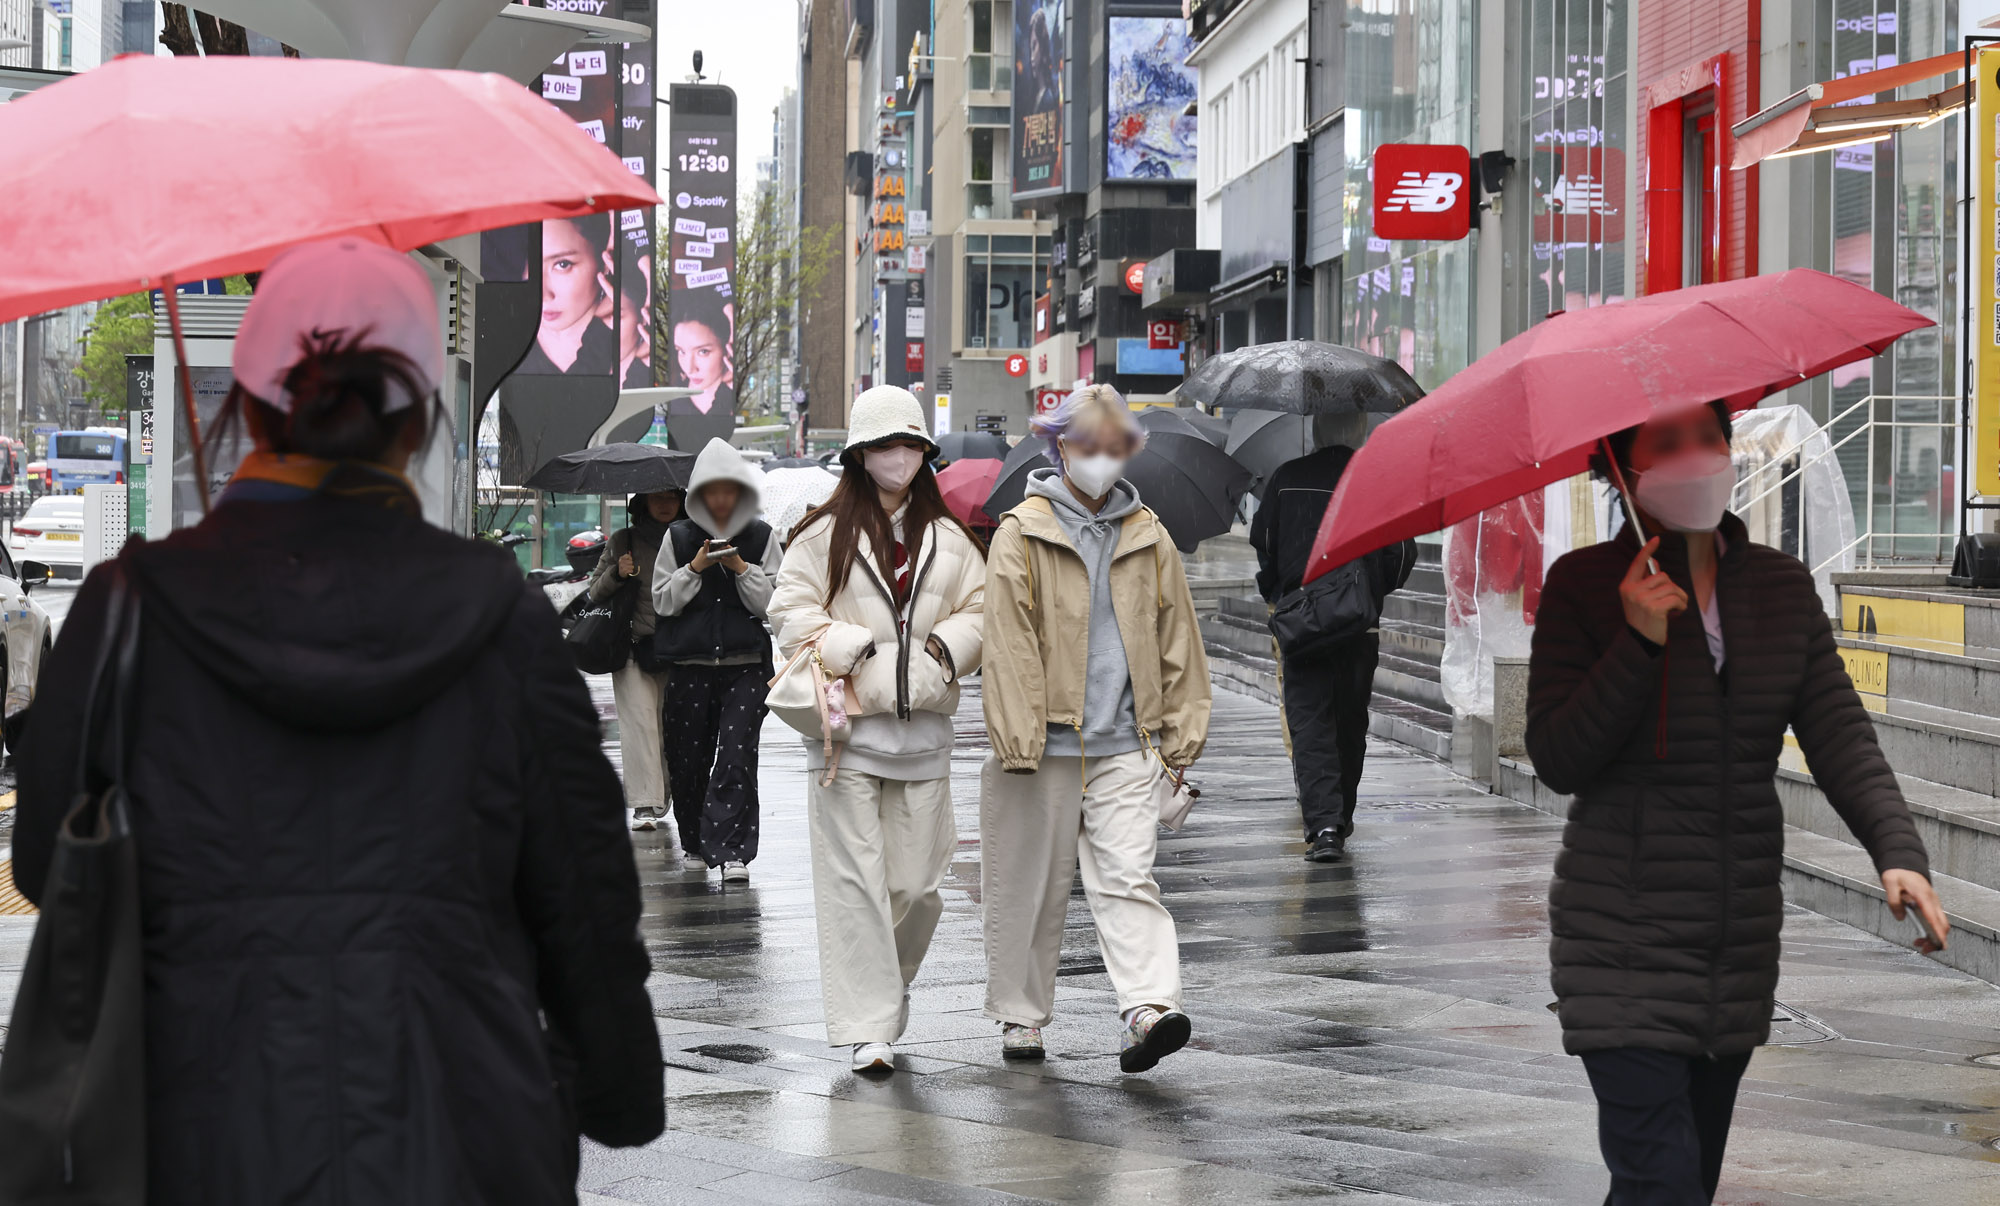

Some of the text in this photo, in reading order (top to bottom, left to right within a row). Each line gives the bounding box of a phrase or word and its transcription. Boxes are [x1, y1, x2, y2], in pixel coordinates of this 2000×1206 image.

[546, 0, 604, 15] Spotify
[590, 57, 601, 68] 더
[554, 82, 576, 94] 아는
[679, 154, 729, 172] 12:30
[692, 196, 728, 208] Spotify
[130, 481, 145, 489] 3412
[1848, 659, 1881, 687] CLINIC
